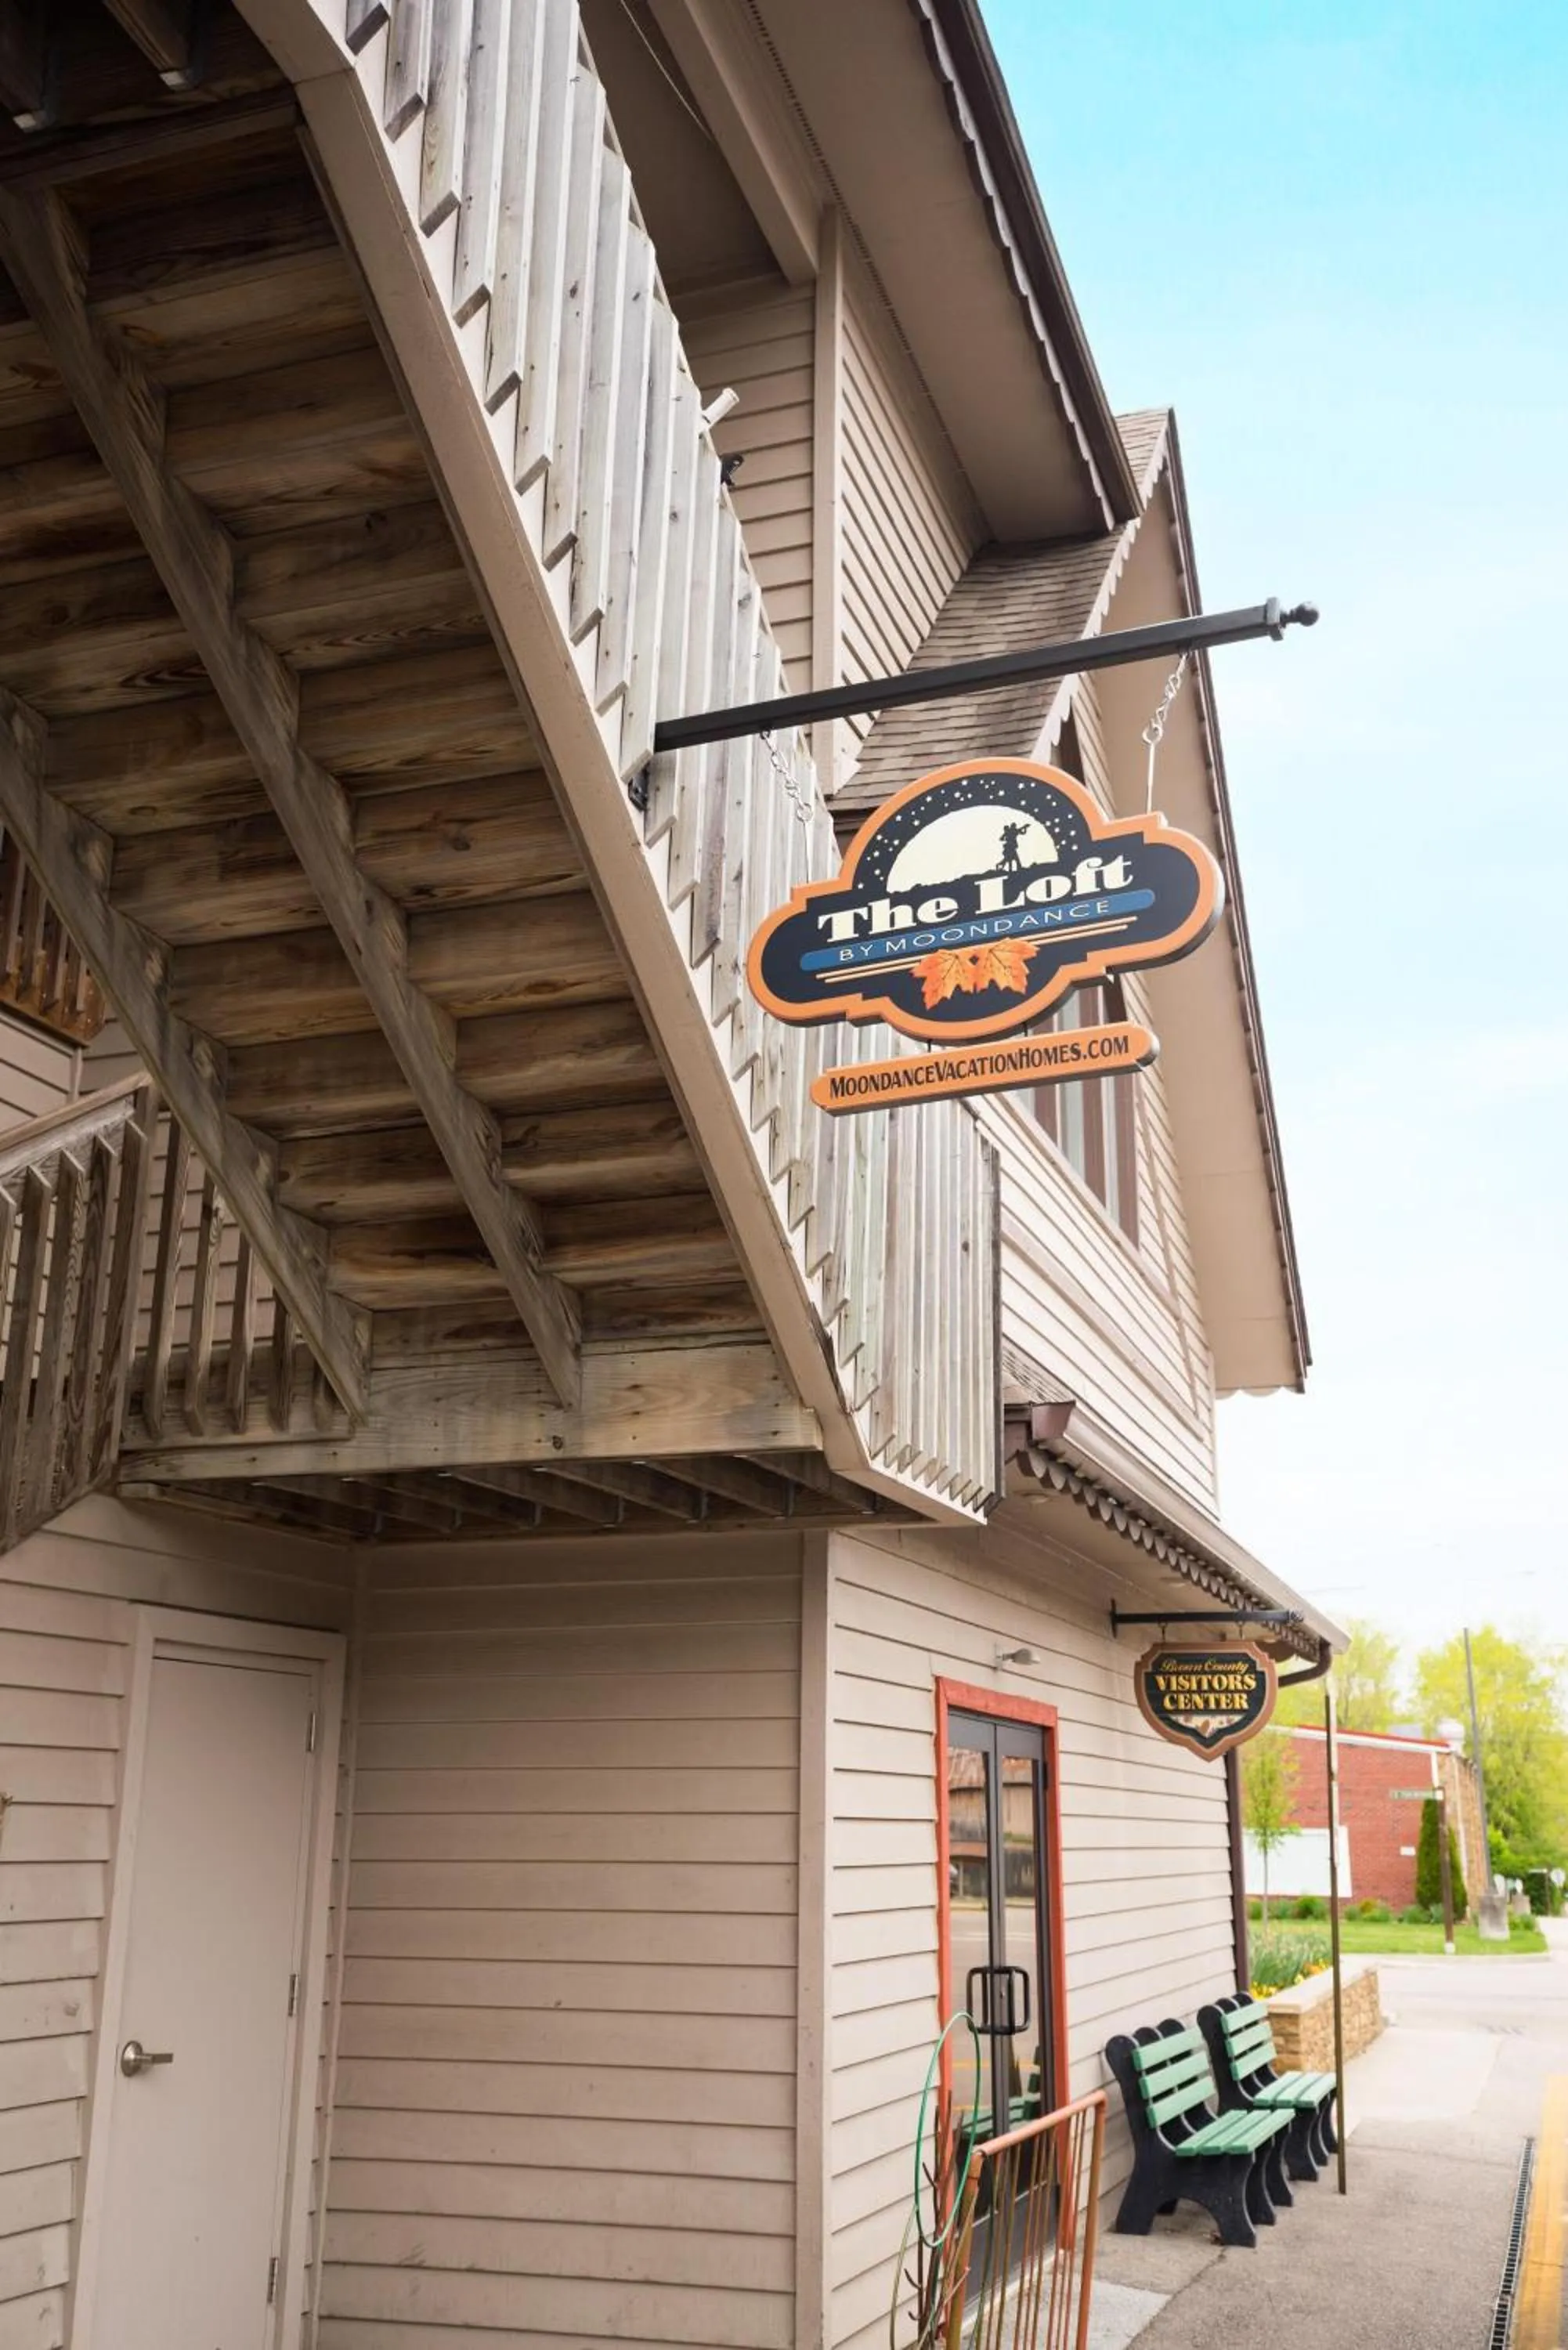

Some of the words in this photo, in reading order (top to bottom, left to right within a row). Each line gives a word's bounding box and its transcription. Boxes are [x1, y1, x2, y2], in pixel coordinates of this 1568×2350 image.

[818, 897, 958, 943] The
[974, 854, 1134, 914] Loft
[840, 944, 873, 963] BY
[886, 899, 1110, 953] MOONDANCE
[1204, 1659, 1248, 1674] County
[1155, 1674, 1256, 1691] VISITORS
[1163, 1693, 1249, 1710] CENTER
